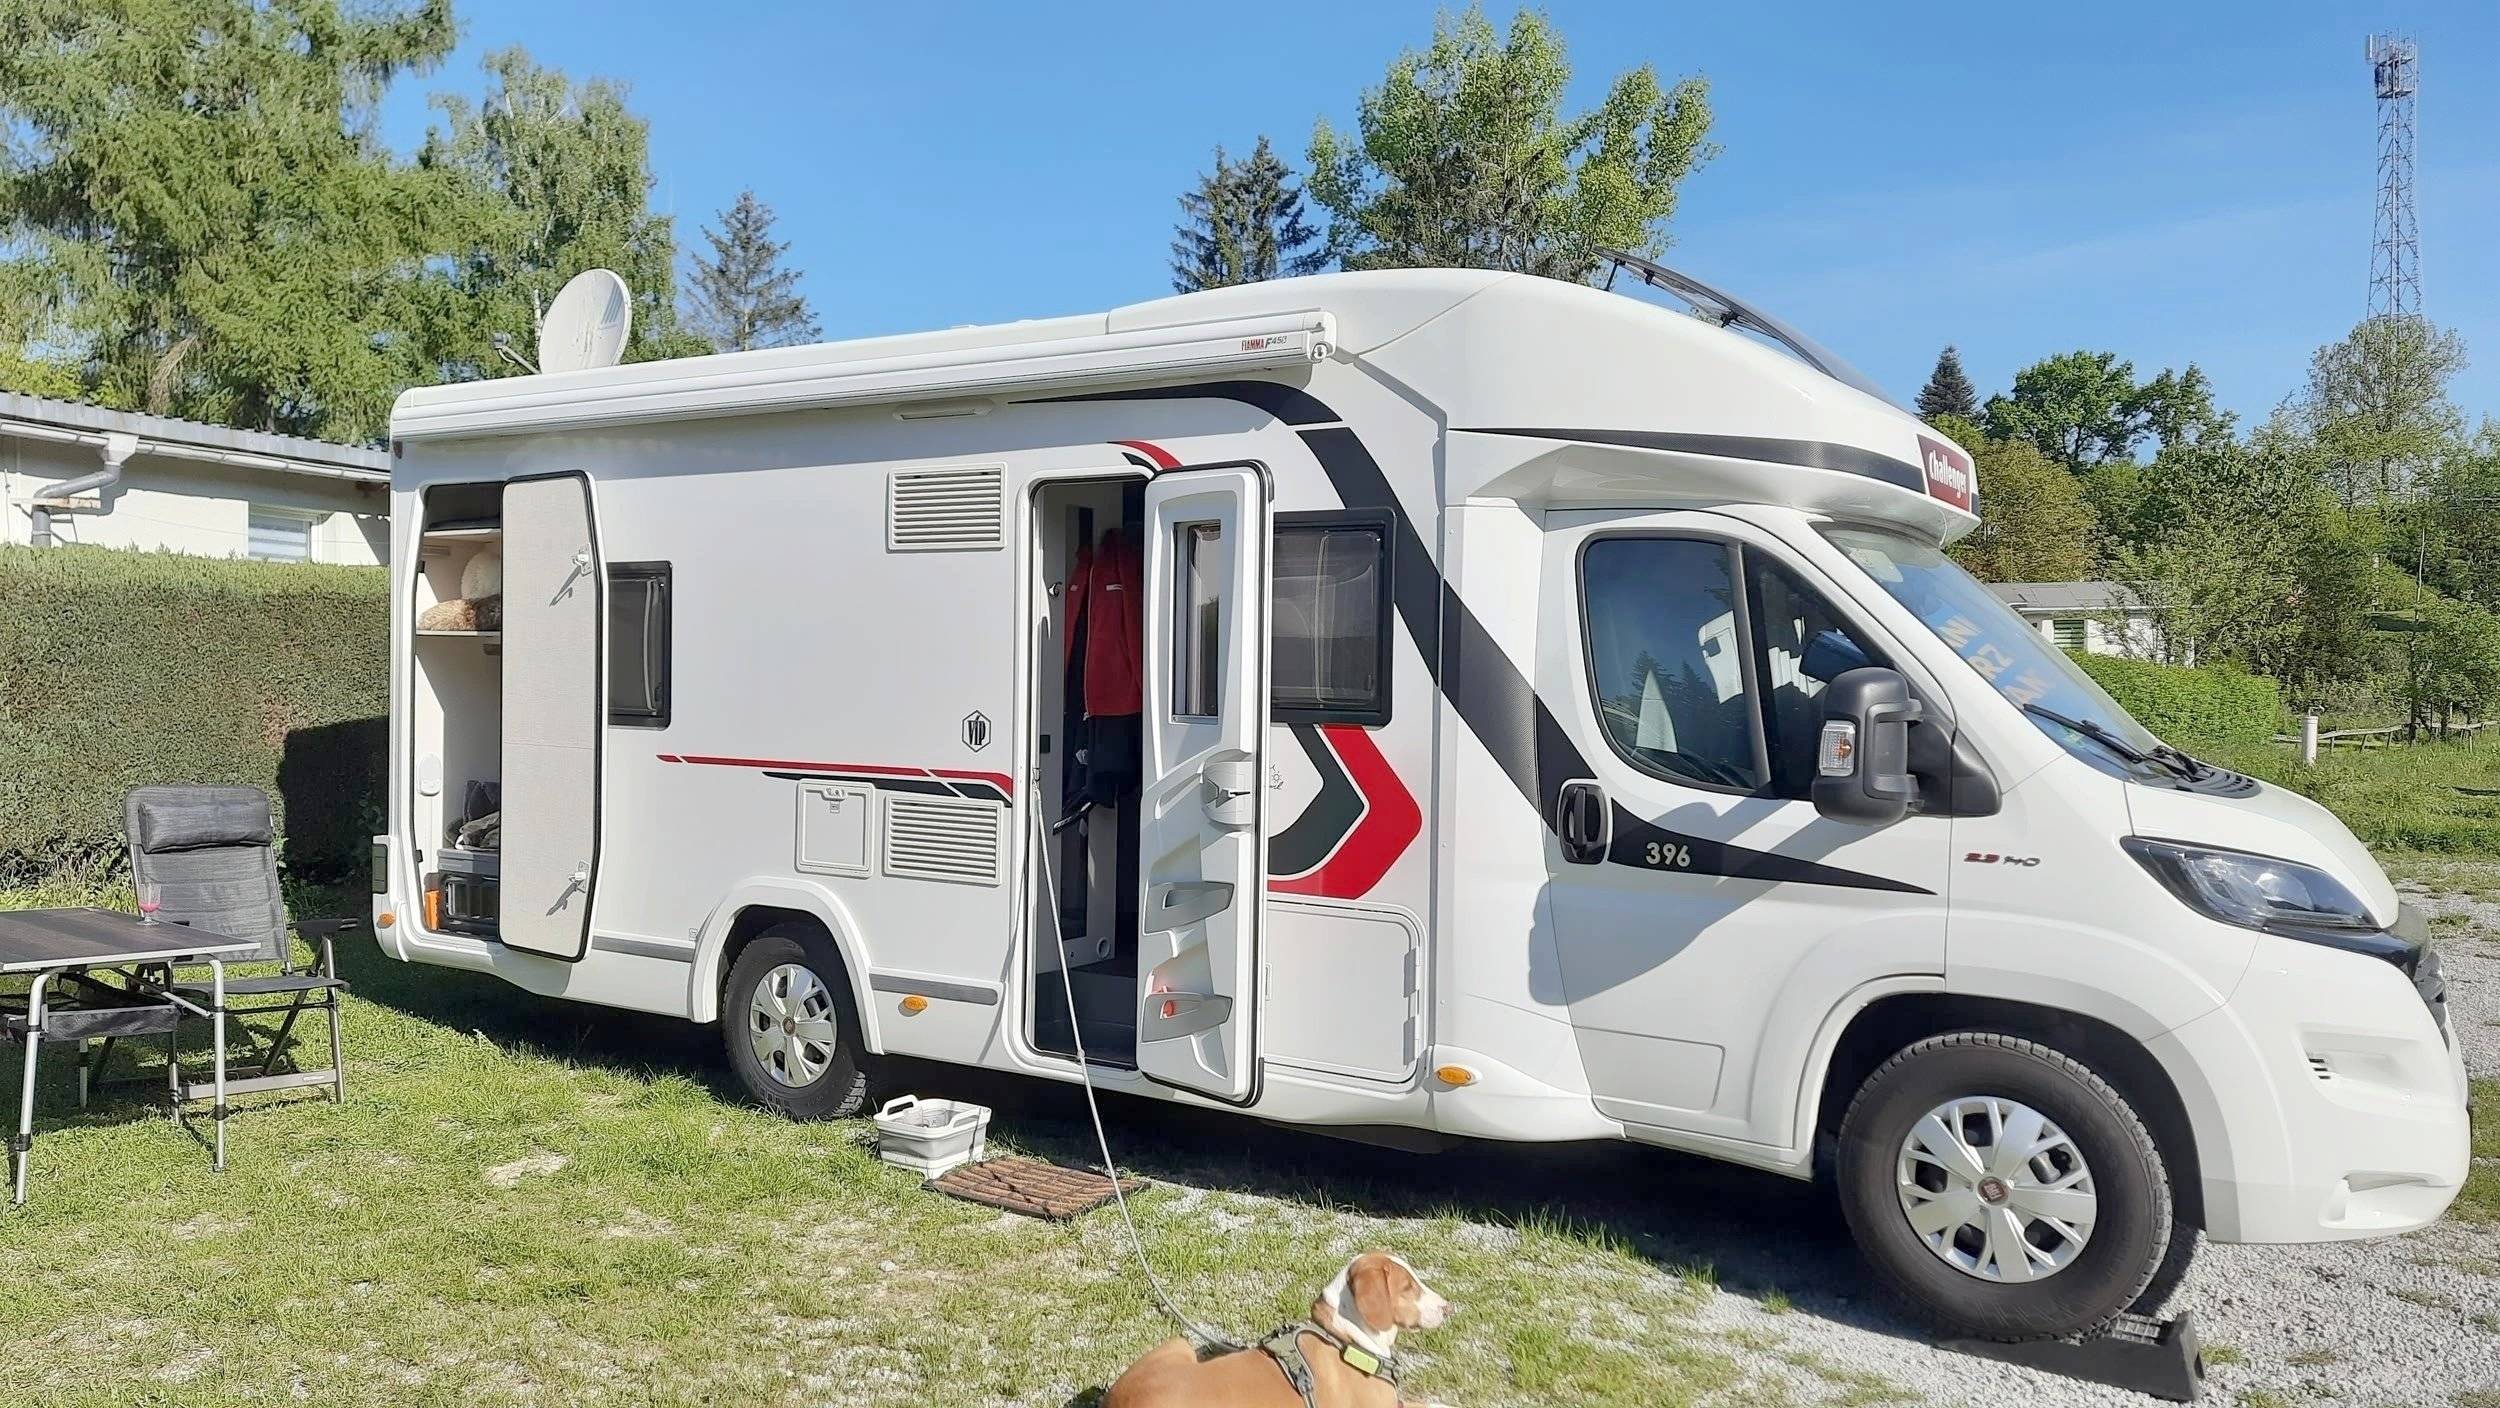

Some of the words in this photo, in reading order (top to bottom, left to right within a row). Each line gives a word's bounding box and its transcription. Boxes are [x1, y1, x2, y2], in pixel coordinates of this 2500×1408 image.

[1241, 338, 1265, 352] FIAMMA
[1929, 449, 1968, 499] Challenger
[1645, 842, 1692, 868] 396
